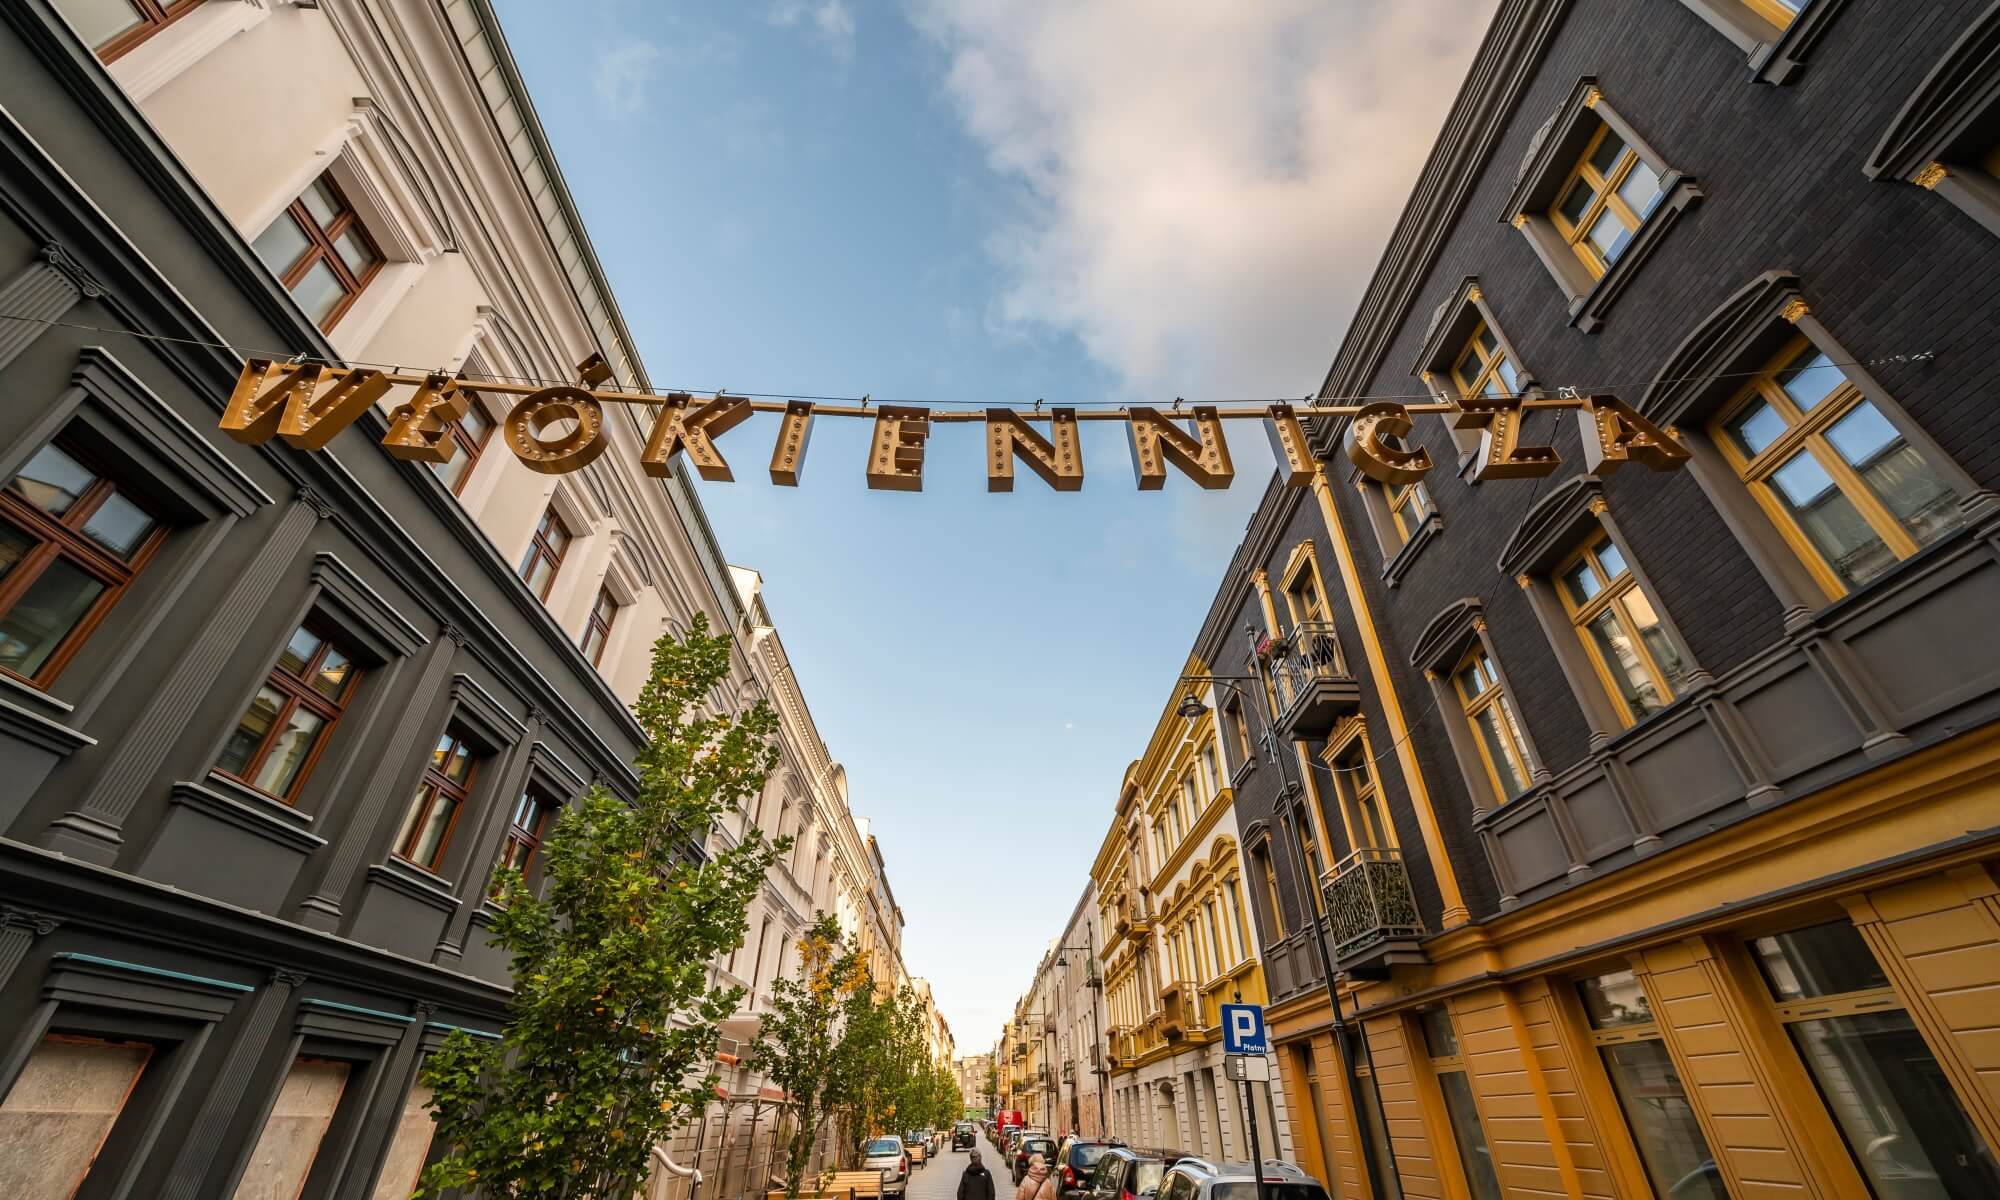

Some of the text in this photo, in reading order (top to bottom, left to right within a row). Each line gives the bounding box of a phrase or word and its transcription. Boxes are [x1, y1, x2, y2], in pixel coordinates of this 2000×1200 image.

[219, 352, 1692, 492] WŁÓKIENNICZA
[1231, 1010, 1256, 1047] P
[1243, 1043, 1265, 1053] Płatny
